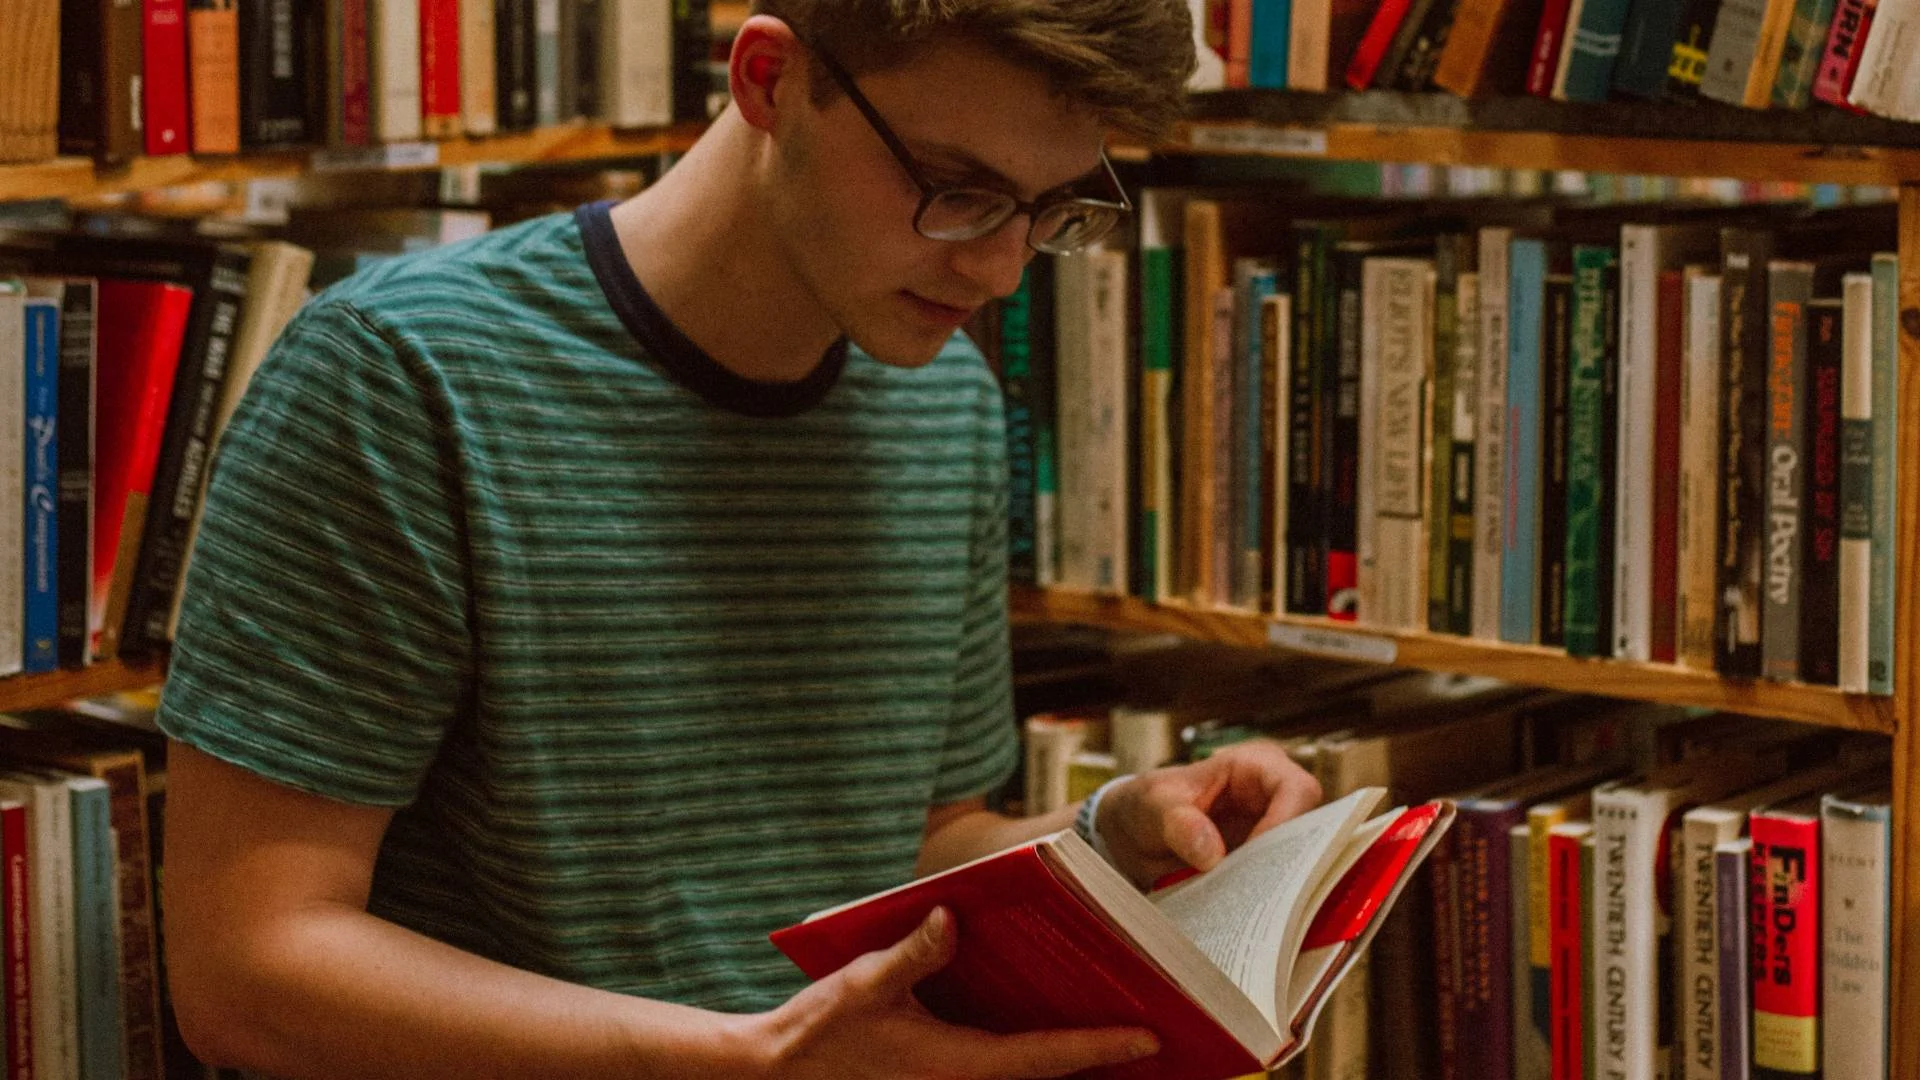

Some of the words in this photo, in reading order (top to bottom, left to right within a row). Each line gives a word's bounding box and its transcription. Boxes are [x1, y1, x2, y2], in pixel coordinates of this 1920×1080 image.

[1771, 445, 1797, 508] Oral
[1768, 513, 1798, 606] Poetry
[1605, 834, 1626, 956] TWENTIETH
[1696, 842, 1714, 965] TWENTIETH
[1605, 965, 1626, 1064] CENTURY
[1696, 974, 1714, 1071] CENTURY
